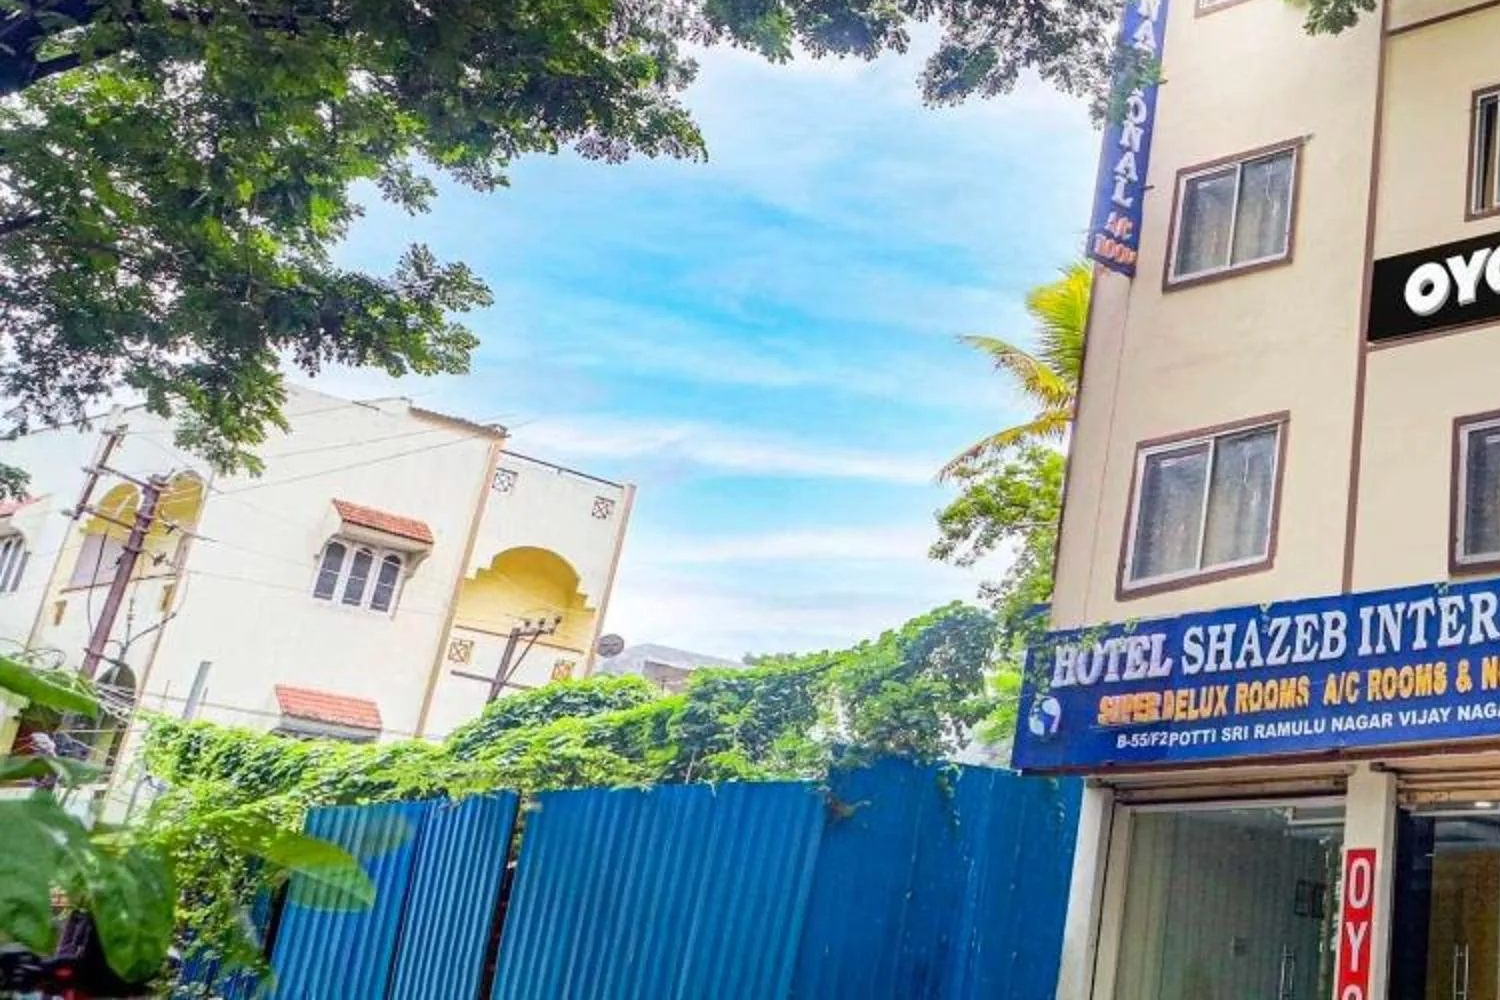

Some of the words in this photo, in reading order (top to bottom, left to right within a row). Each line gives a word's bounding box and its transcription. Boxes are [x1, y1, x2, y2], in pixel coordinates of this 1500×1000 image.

[1051, 633, 1173, 688] HOTEL
[1182, 608, 1347, 676] SHAZEB
[1162, 684, 1229, 722] DELUX
[1235, 675, 1310, 715] ROOMS
[1323, 671, 1360, 706] A/C
[1367, 661, 1448, 701] ROOMS
[1456, 659, 1473, 694] &
[1221, 725, 1249, 742] SRI
[1253, 718, 1326, 739] RAMULU
[1331, 712, 1393, 732] NAGAR
[1398, 706, 1452, 726] VIJAY
